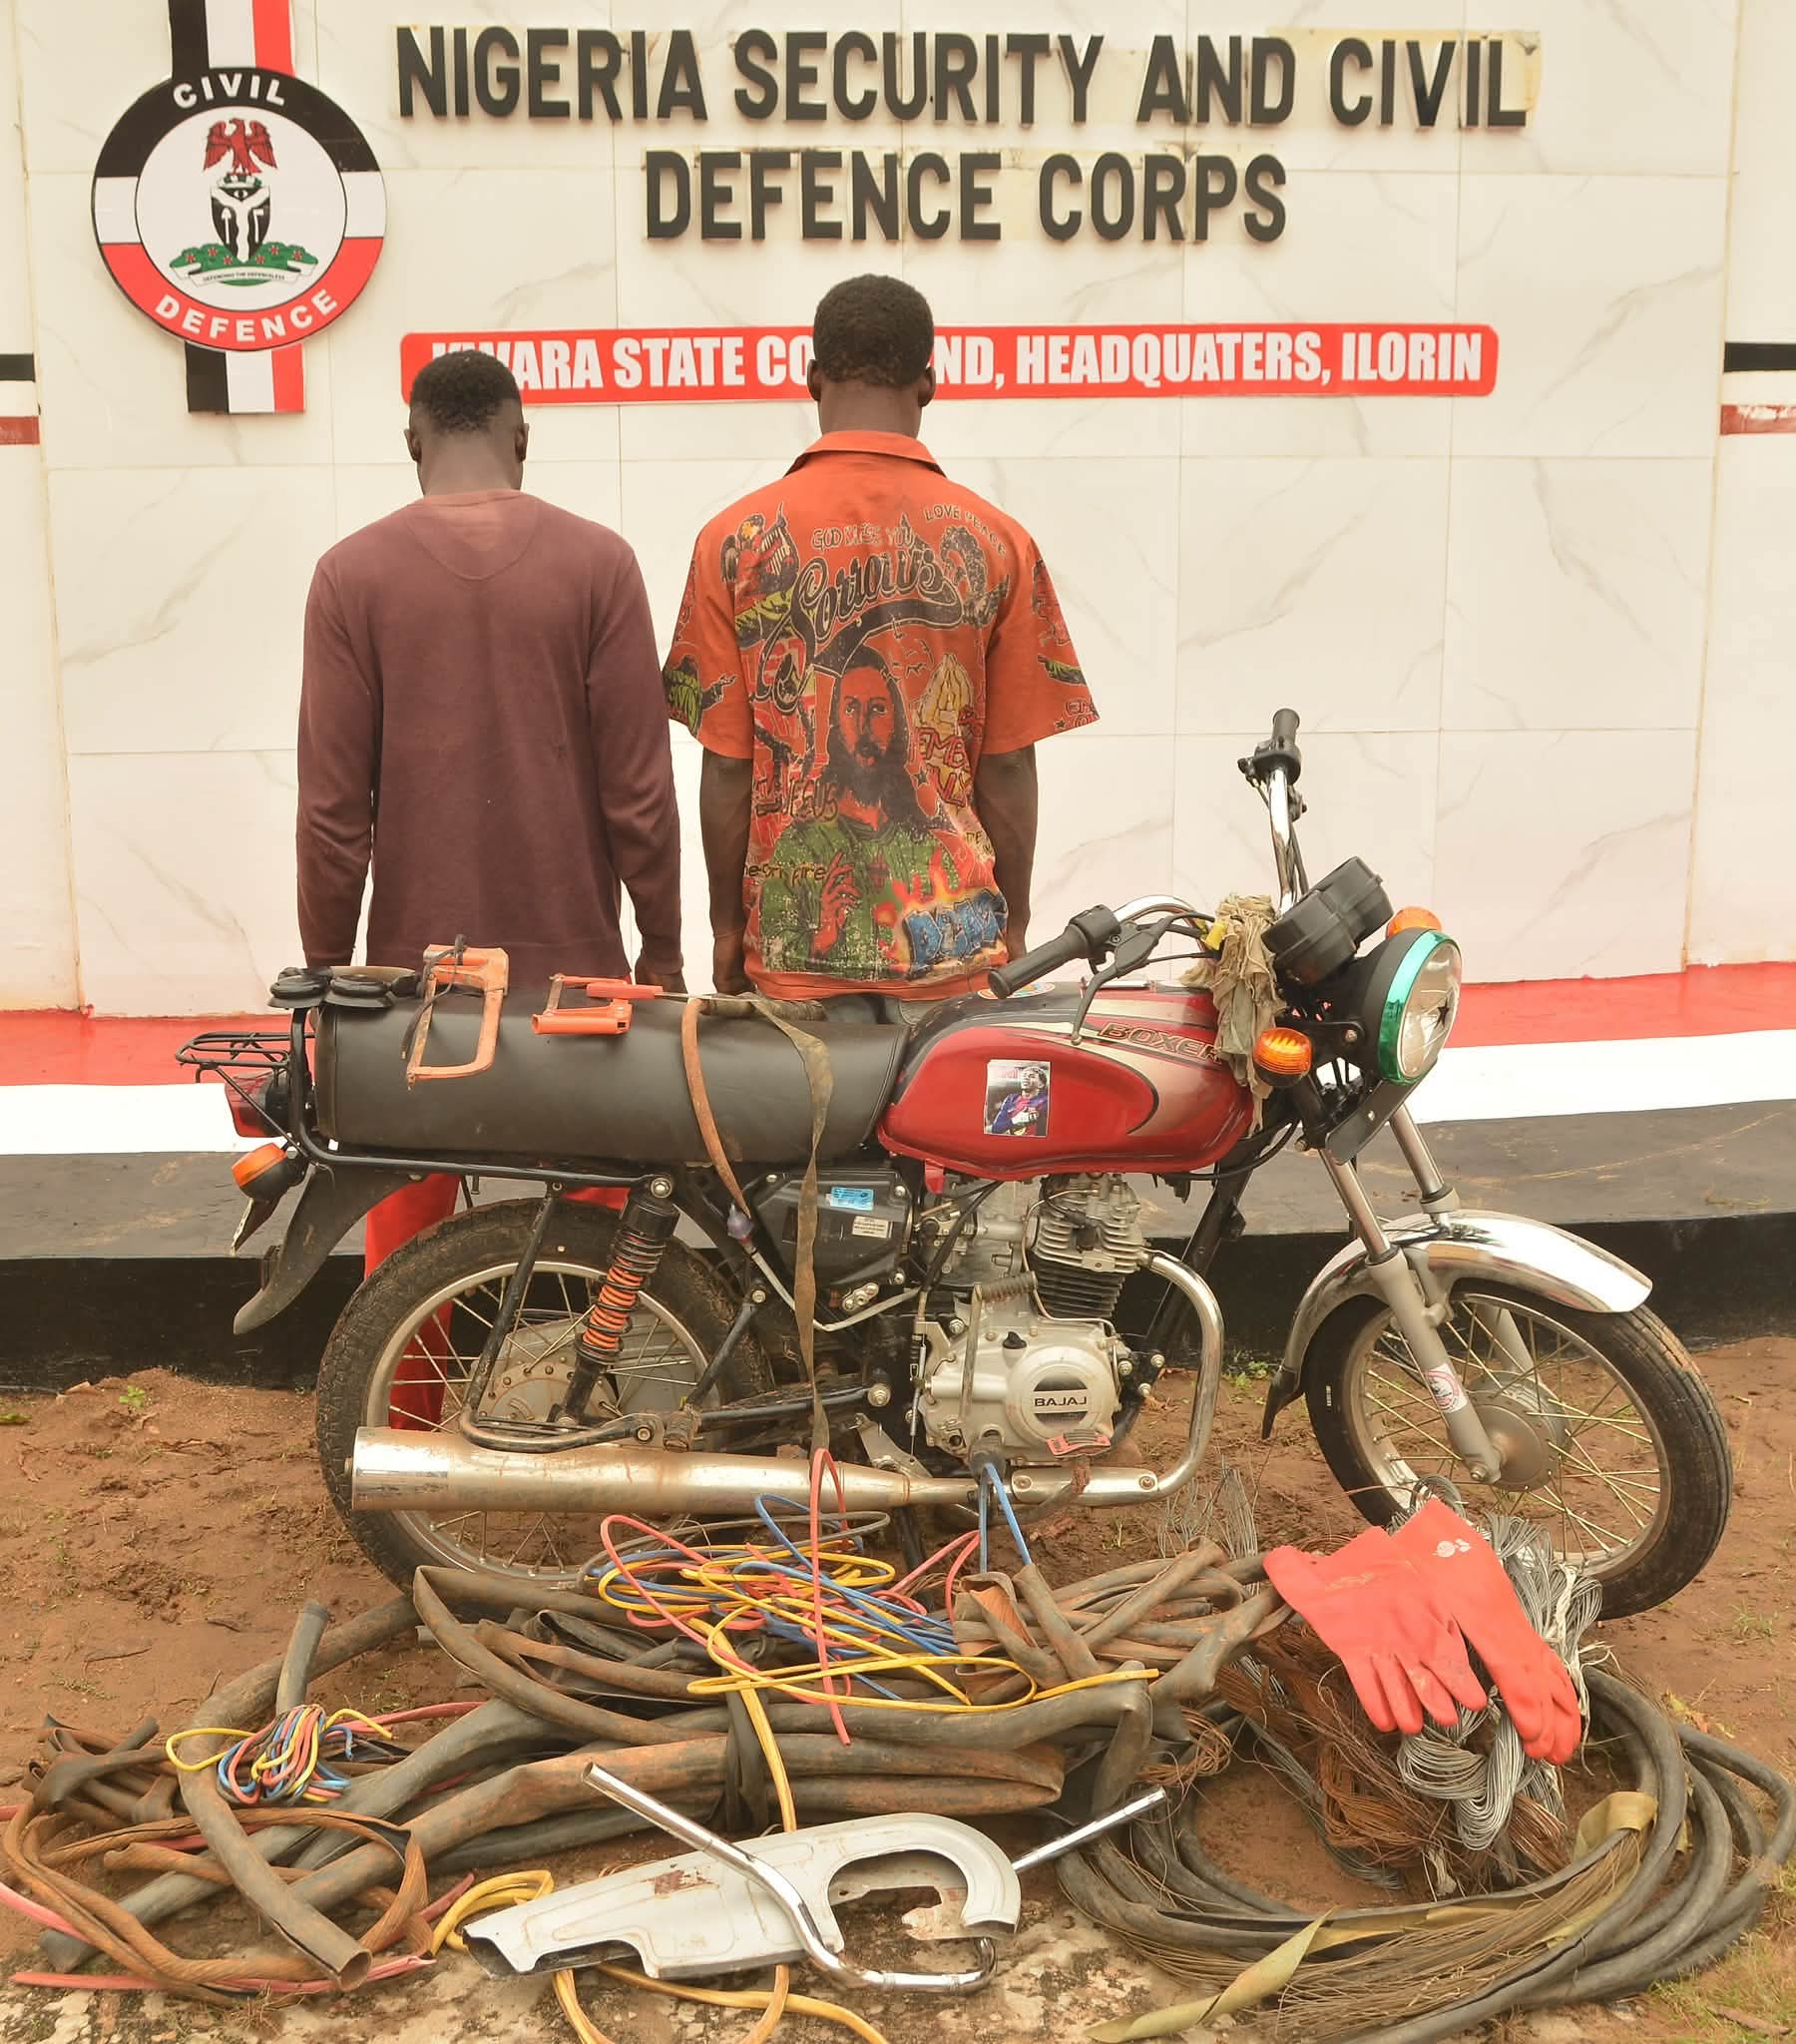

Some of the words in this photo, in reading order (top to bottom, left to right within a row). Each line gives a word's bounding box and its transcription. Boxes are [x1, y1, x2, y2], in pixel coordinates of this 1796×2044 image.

[173, 73, 285, 108] CIVIL
[397, 25, 709, 121] NIGERIA
[733, 28, 1106, 125] SECURITY
[1134, 34, 1296, 126] AND
[1329, 37, 1528, 129] CIVIL
[645, 150, 1002, 241] DEFENCE
[1039, 152, 1287, 242] CORPS
[156, 288, 338, 343] DEFENCE
[613, 335, 745, 388] STATE
[756, 334, 1005, 390] COND,
[1016, 331, 1331, 388] HEADQUATERS,
[1341, 331, 1483, 382] ILORIN
[924, 504, 962, 524] LOVE
[1034, 1396, 1088, 1407] BAJAJ
